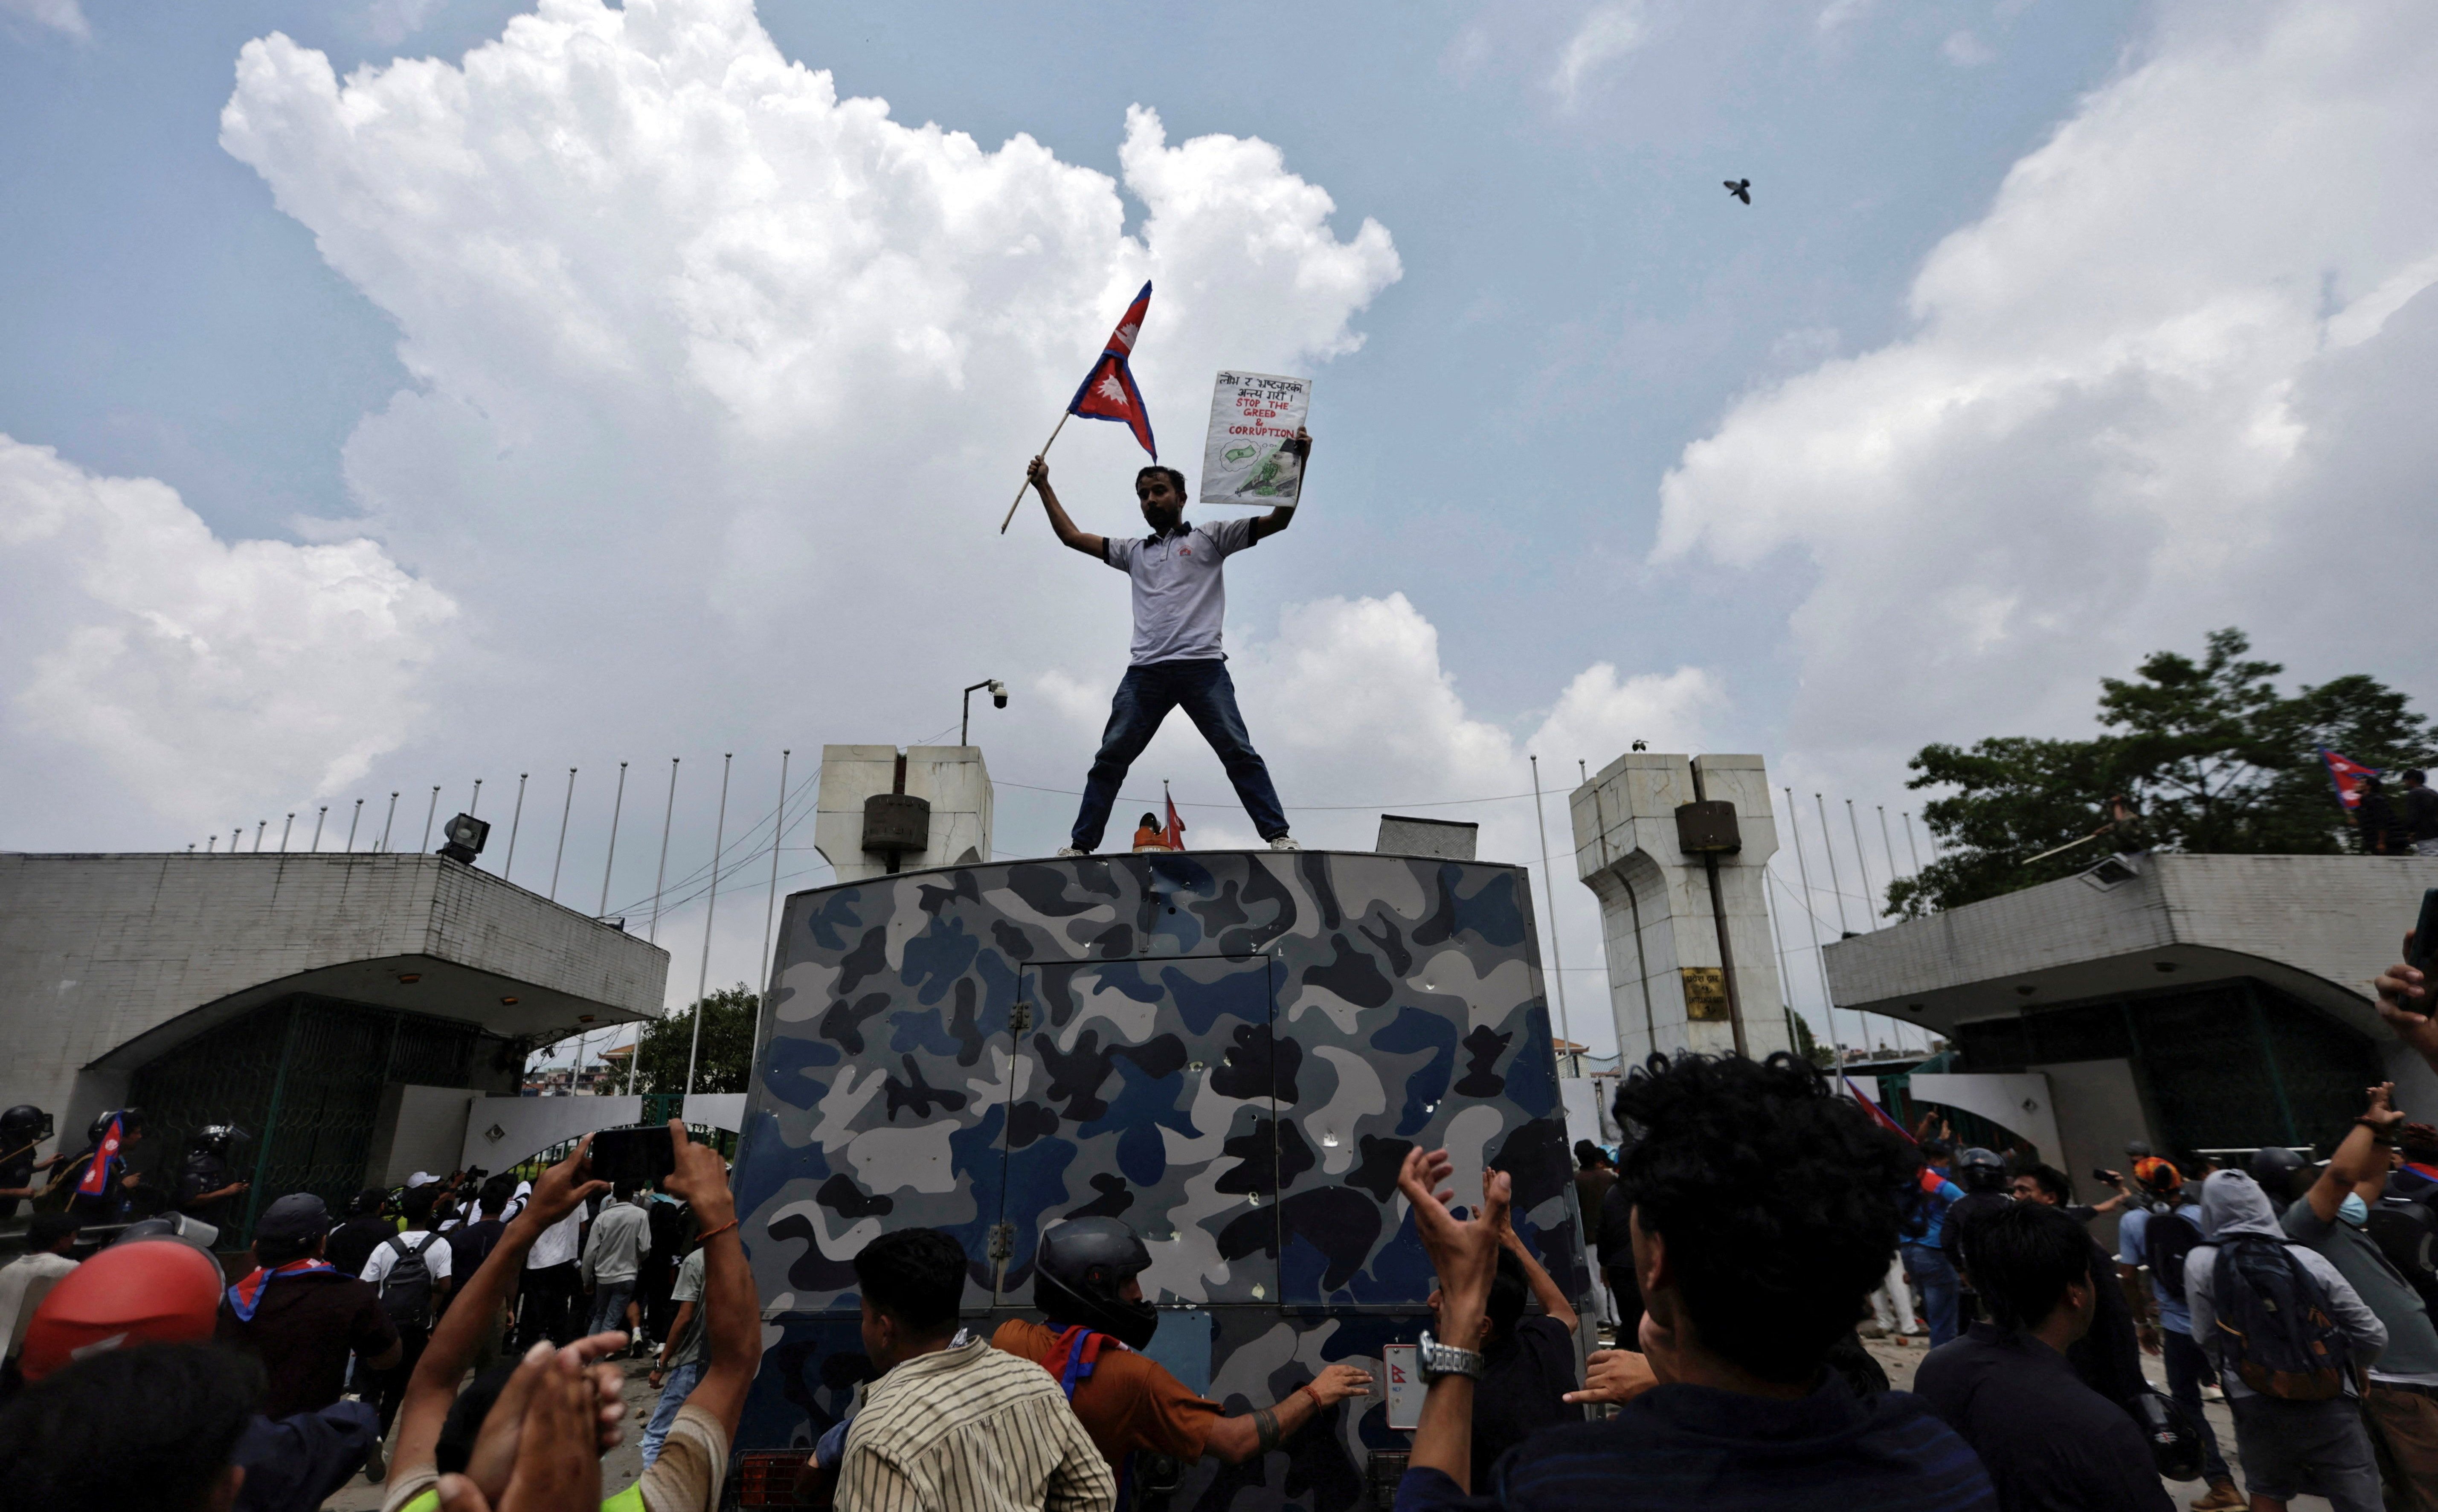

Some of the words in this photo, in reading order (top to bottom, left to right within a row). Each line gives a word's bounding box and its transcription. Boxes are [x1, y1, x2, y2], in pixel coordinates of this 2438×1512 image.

[1220, 372, 1240, 385] लोभ
[1245, 377, 1253, 386] र
[1236, 398, 1260, 407] STOP
[1268, 400, 1289, 410] THE
[1243, 408, 1276, 418] GREED
